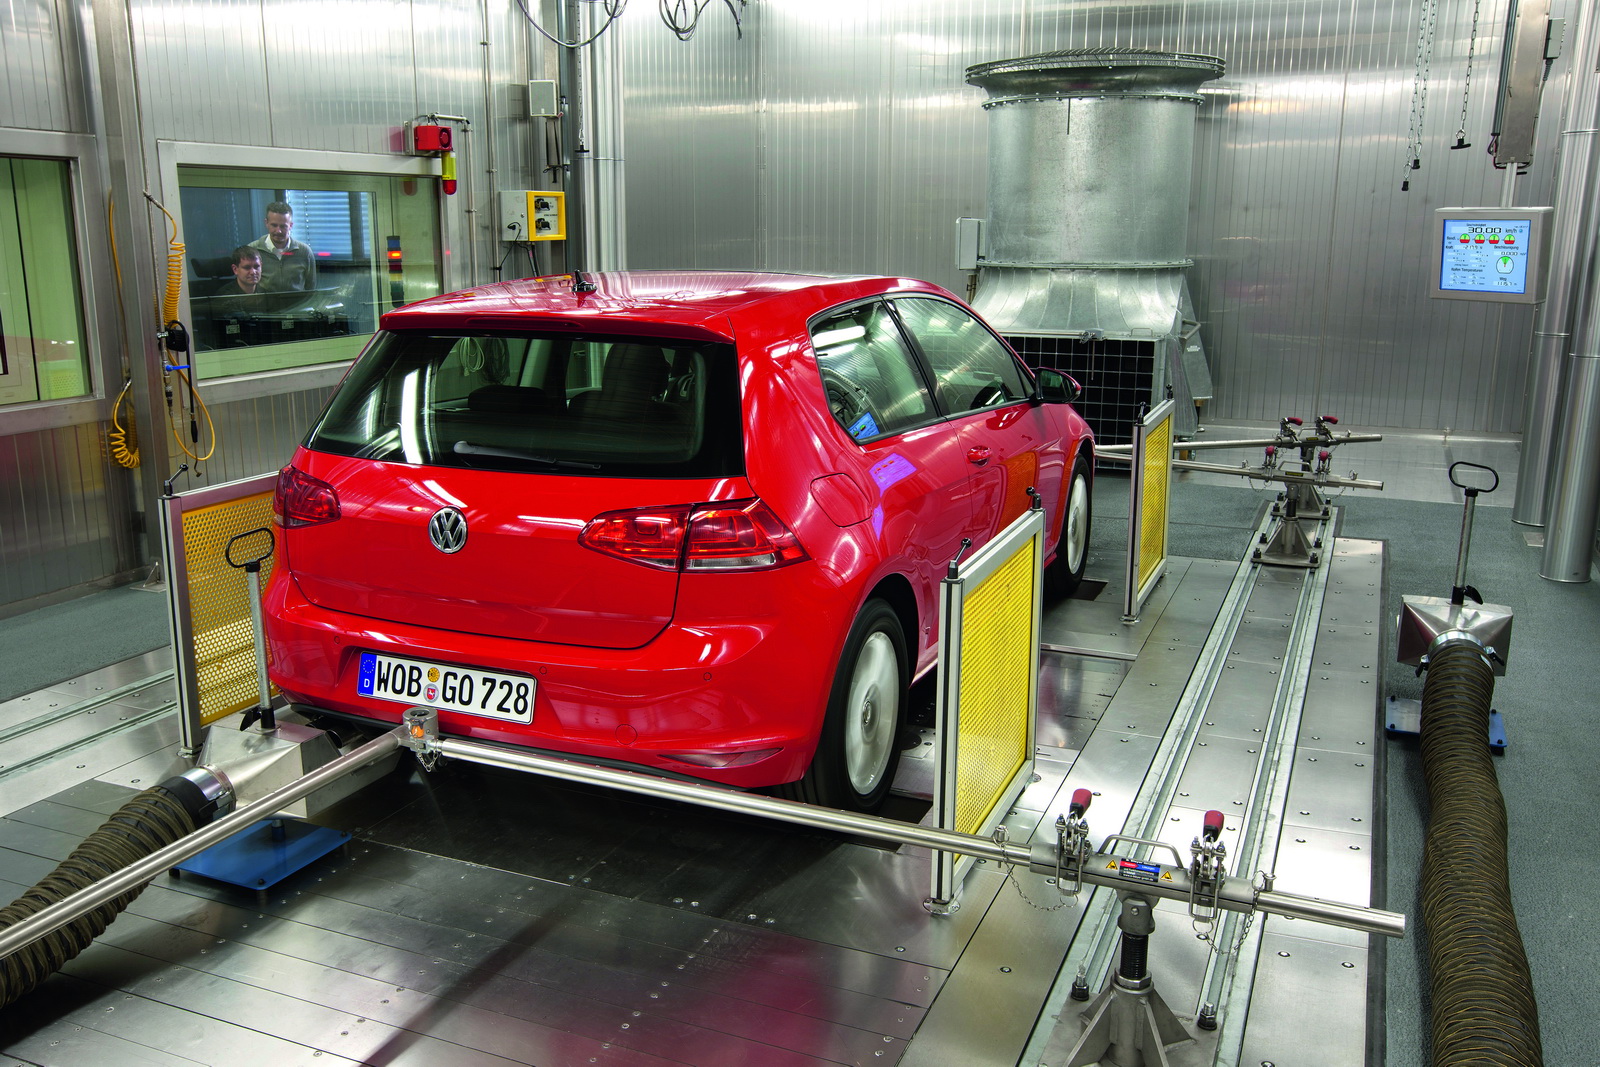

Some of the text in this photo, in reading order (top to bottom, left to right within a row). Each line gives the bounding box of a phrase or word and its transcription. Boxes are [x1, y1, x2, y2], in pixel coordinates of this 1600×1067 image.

[364, 678, 370, 688] D
[377, 660, 529, 715] WOB GO 728
